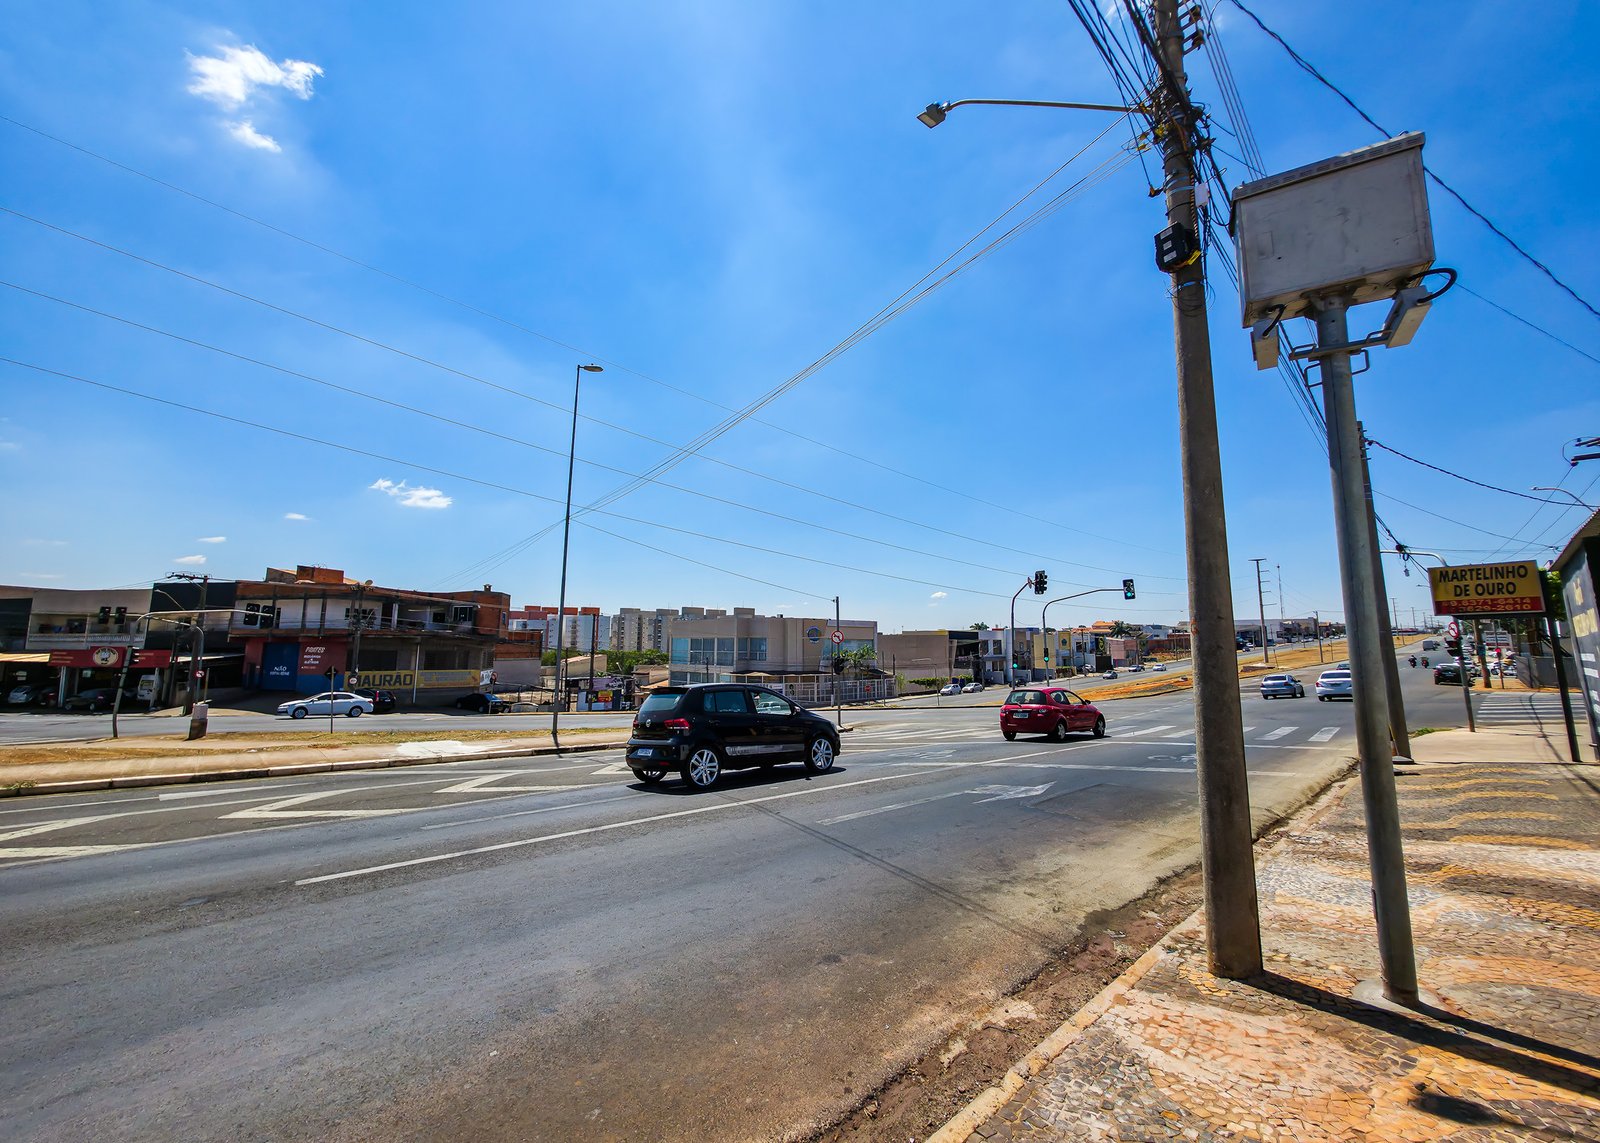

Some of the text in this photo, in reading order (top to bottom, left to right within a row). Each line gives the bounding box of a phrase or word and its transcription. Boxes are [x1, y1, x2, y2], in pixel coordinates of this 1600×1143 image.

[1440, 564, 1528, 583] MARTELINHO
[1454, 582, 1517, 597] DE OURO
